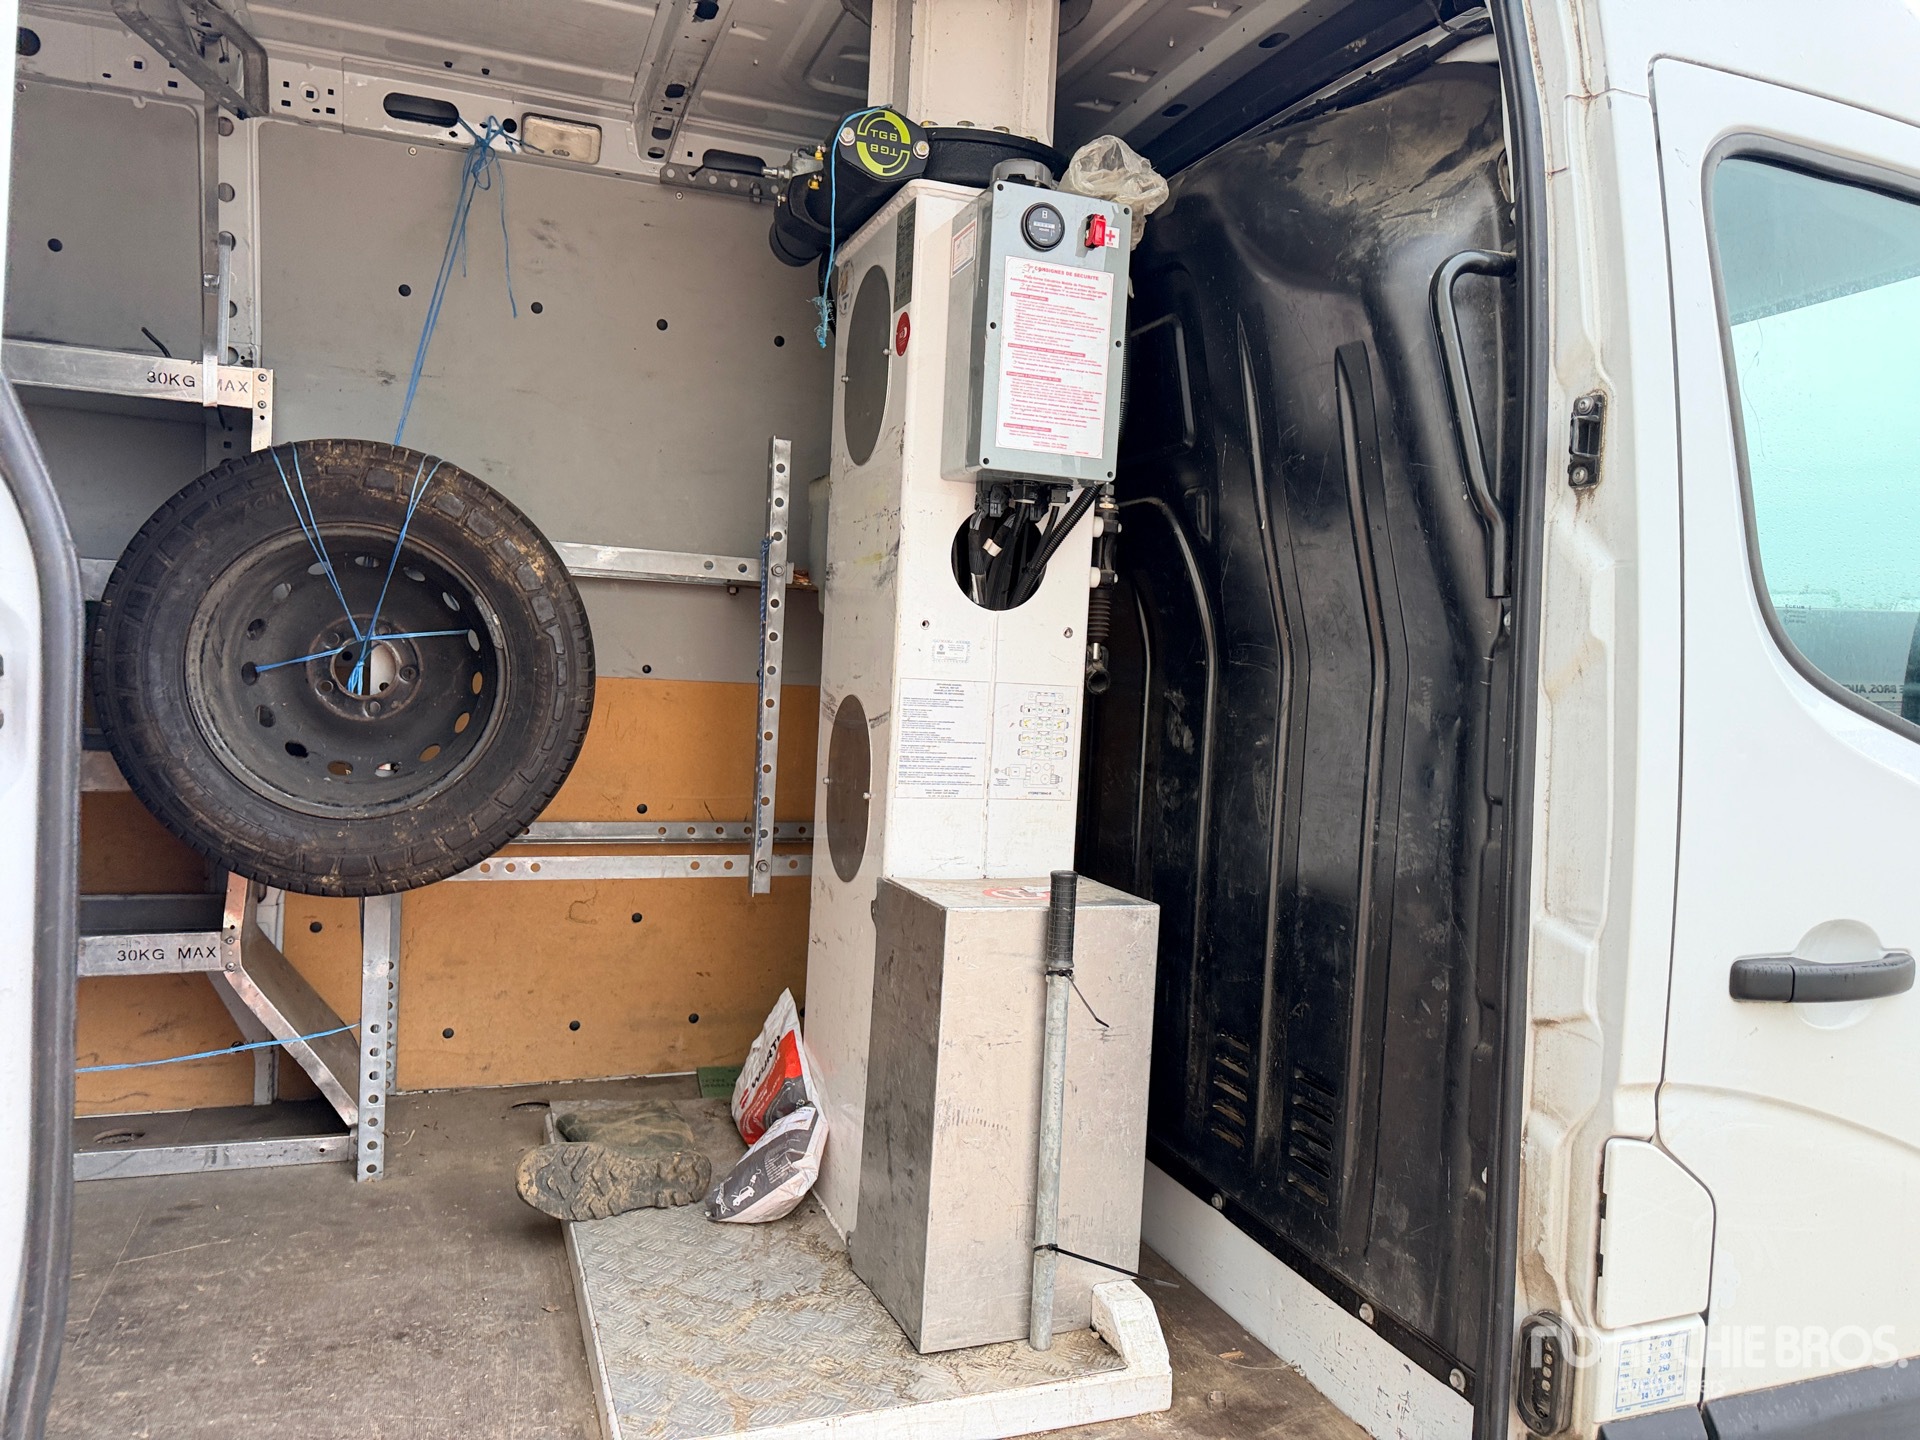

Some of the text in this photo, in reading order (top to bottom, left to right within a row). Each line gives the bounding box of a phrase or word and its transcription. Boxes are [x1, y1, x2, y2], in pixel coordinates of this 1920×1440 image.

[870, 129, 898, 142] TGB
[870, 144, 898, 157] TGB
[146, 370, 196, 388] 30KG
[116, 946, 217, 962] 30KG MAX
